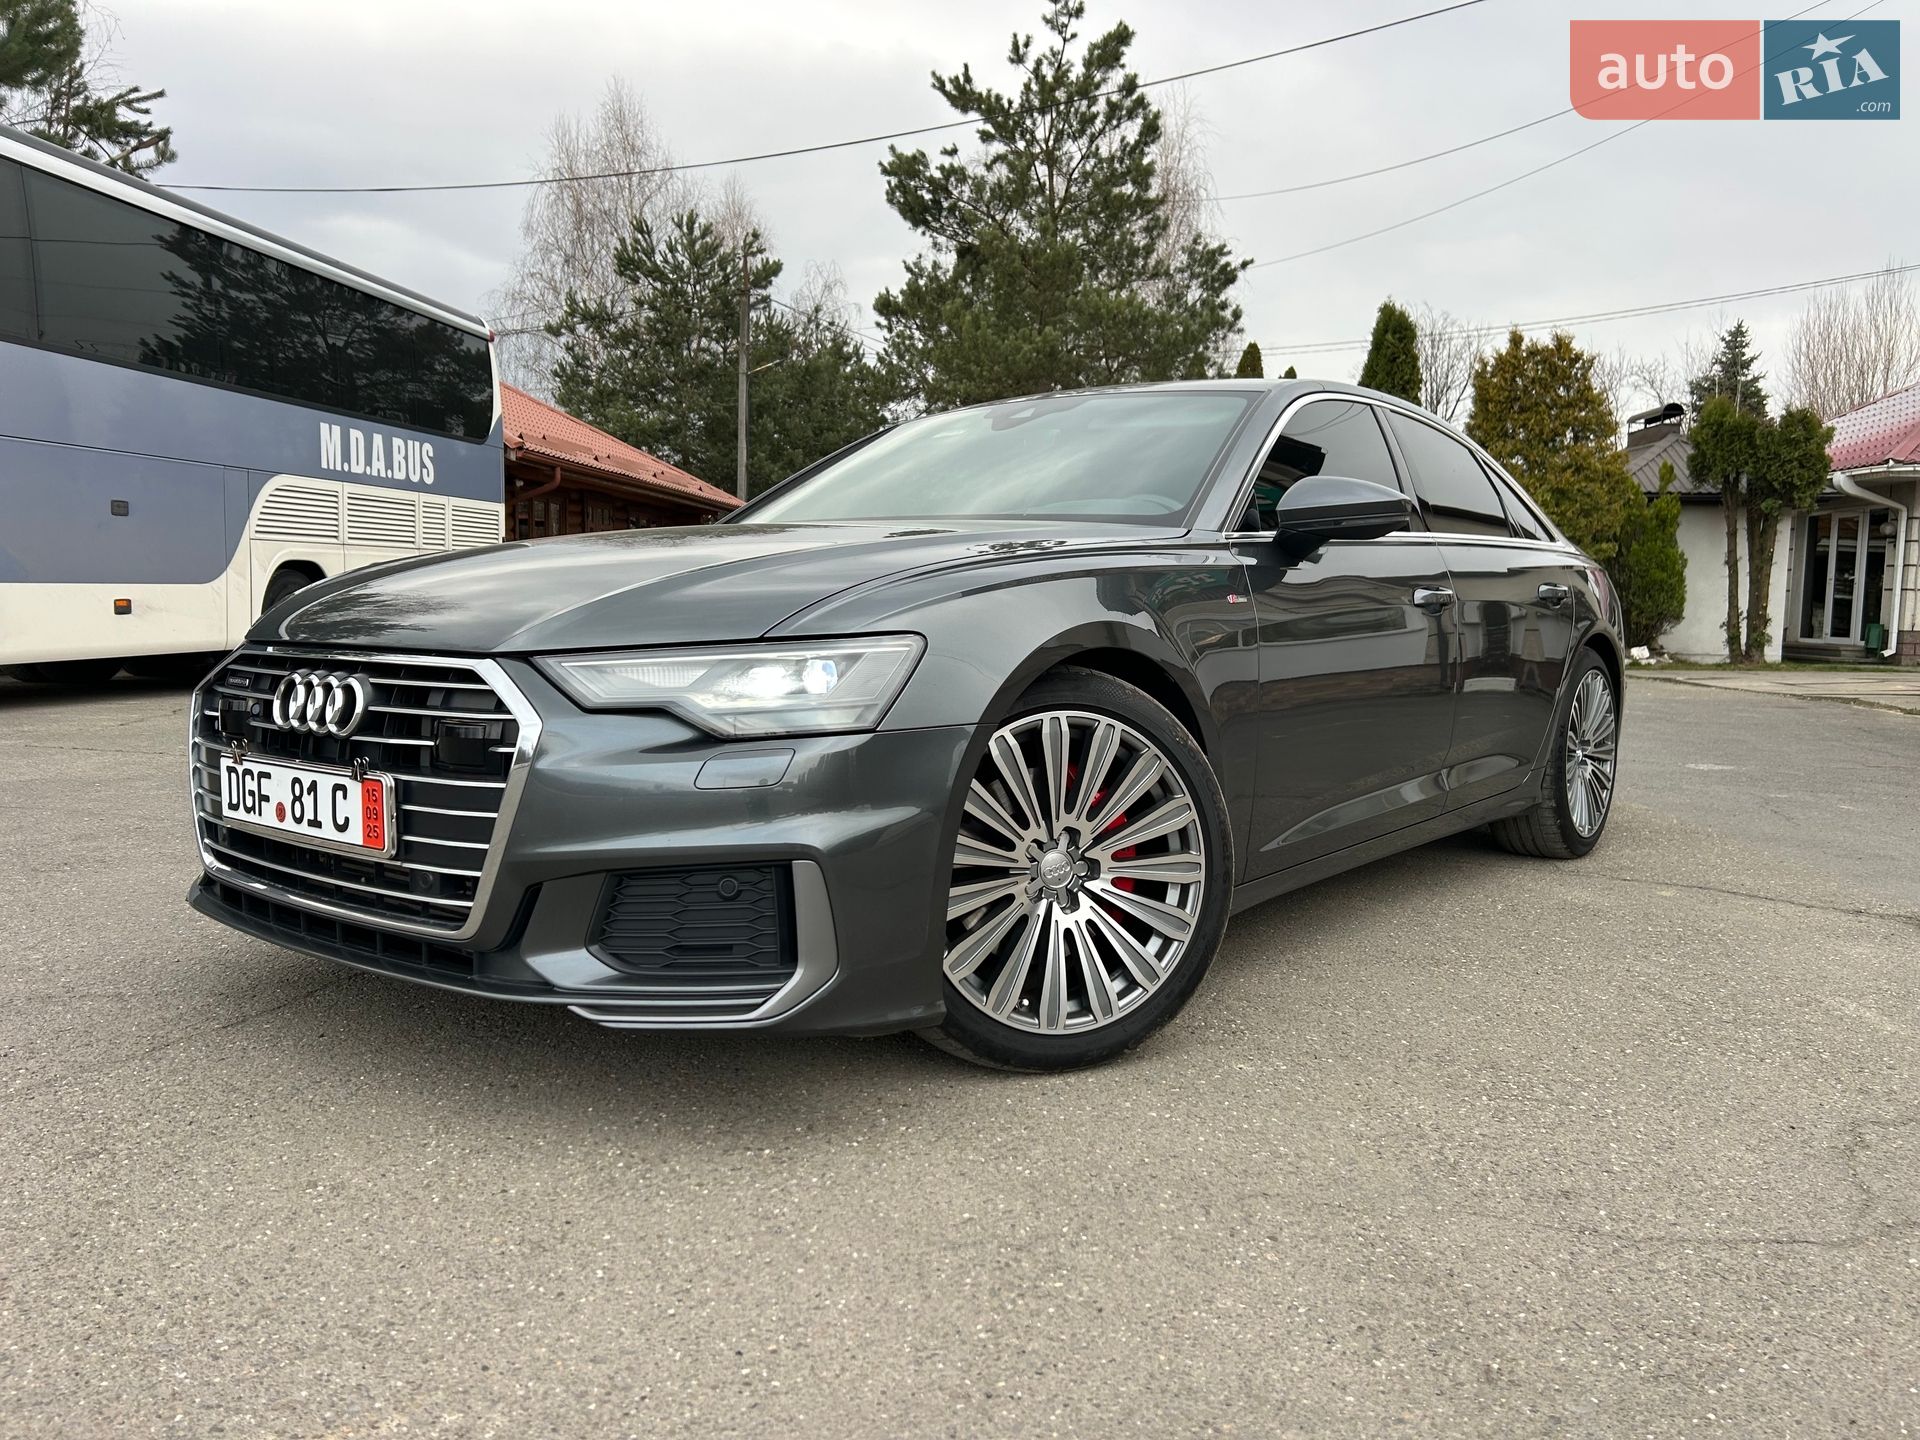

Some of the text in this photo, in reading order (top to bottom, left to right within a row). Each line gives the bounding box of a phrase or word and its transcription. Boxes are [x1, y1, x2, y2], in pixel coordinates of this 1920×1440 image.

[320, 422, 435, 485] M.D.A.BUS
[226, 766, 271, 817] DGF
[290, 777, 322, 829] 81
[331, 783, 350, 833] C
[365, 787, 378, 803] 15
[365, 806, 378, 820] 09
[366, 823, 379, 839] 25
